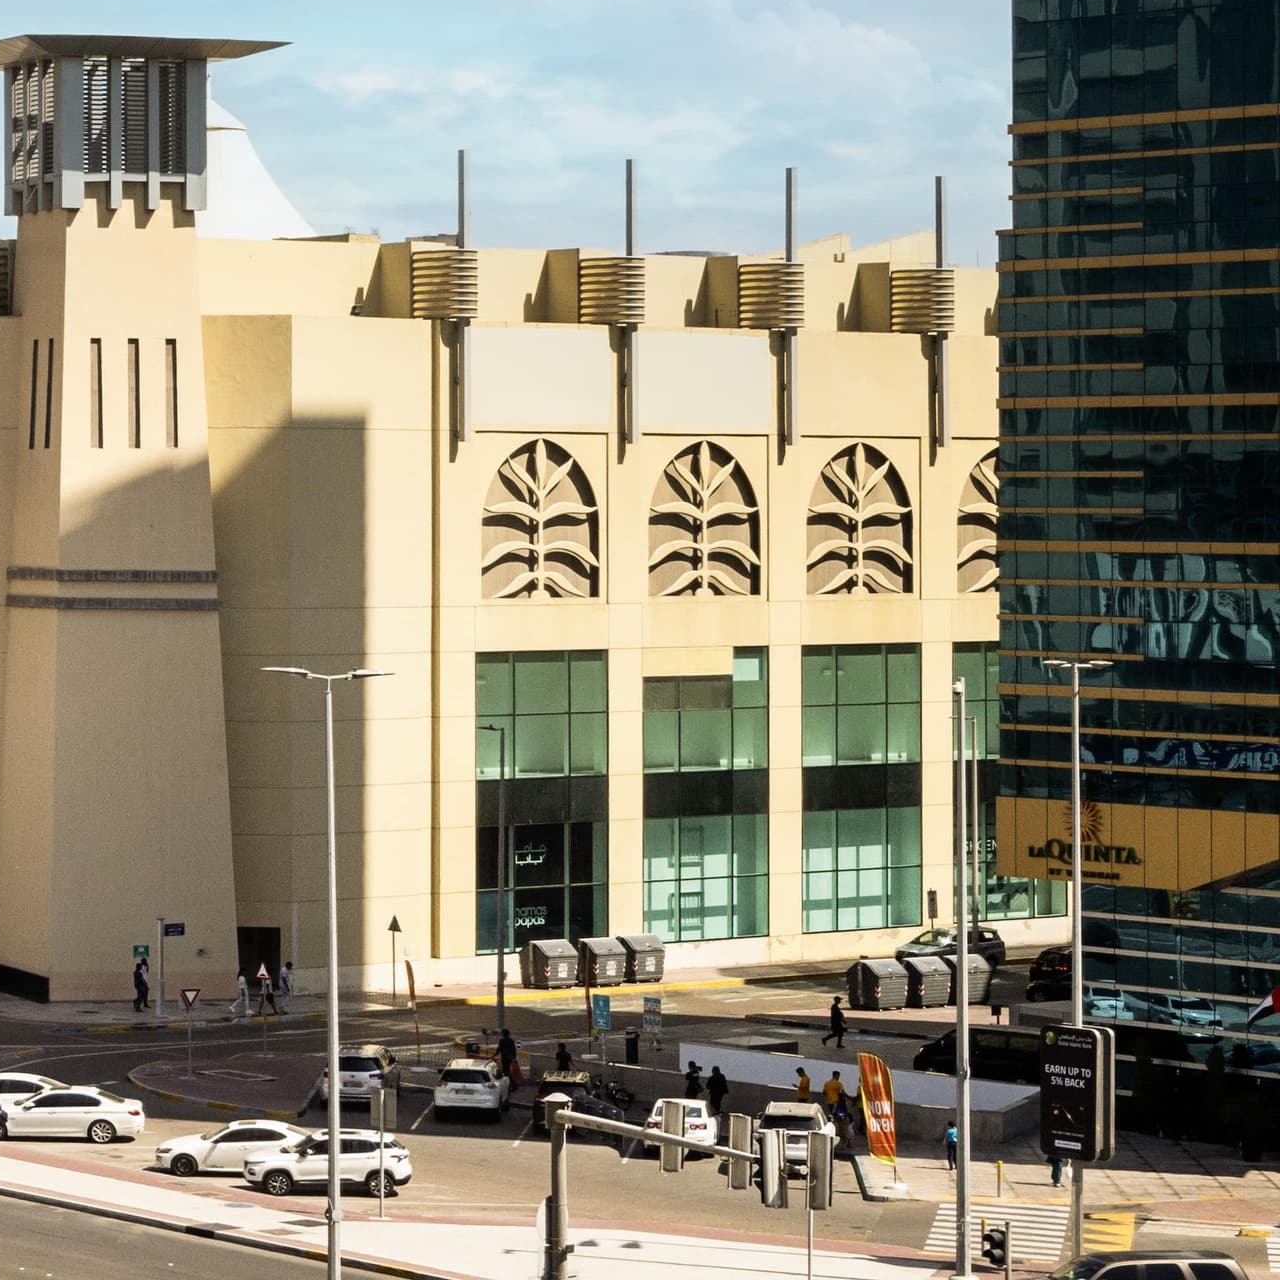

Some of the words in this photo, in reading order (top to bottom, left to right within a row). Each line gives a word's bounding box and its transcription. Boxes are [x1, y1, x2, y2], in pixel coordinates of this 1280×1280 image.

[1044, 1063, 1067, 1076] EARN
[1068, 1066, 1080, 1076] UP
[1081, 1068, 1092, 1078] TO
[1051, 1075, 1064, 1086] 5%
[1064, 1078, 1086, 1089] BACK
[868, 1100, 891, 1115] NOW
